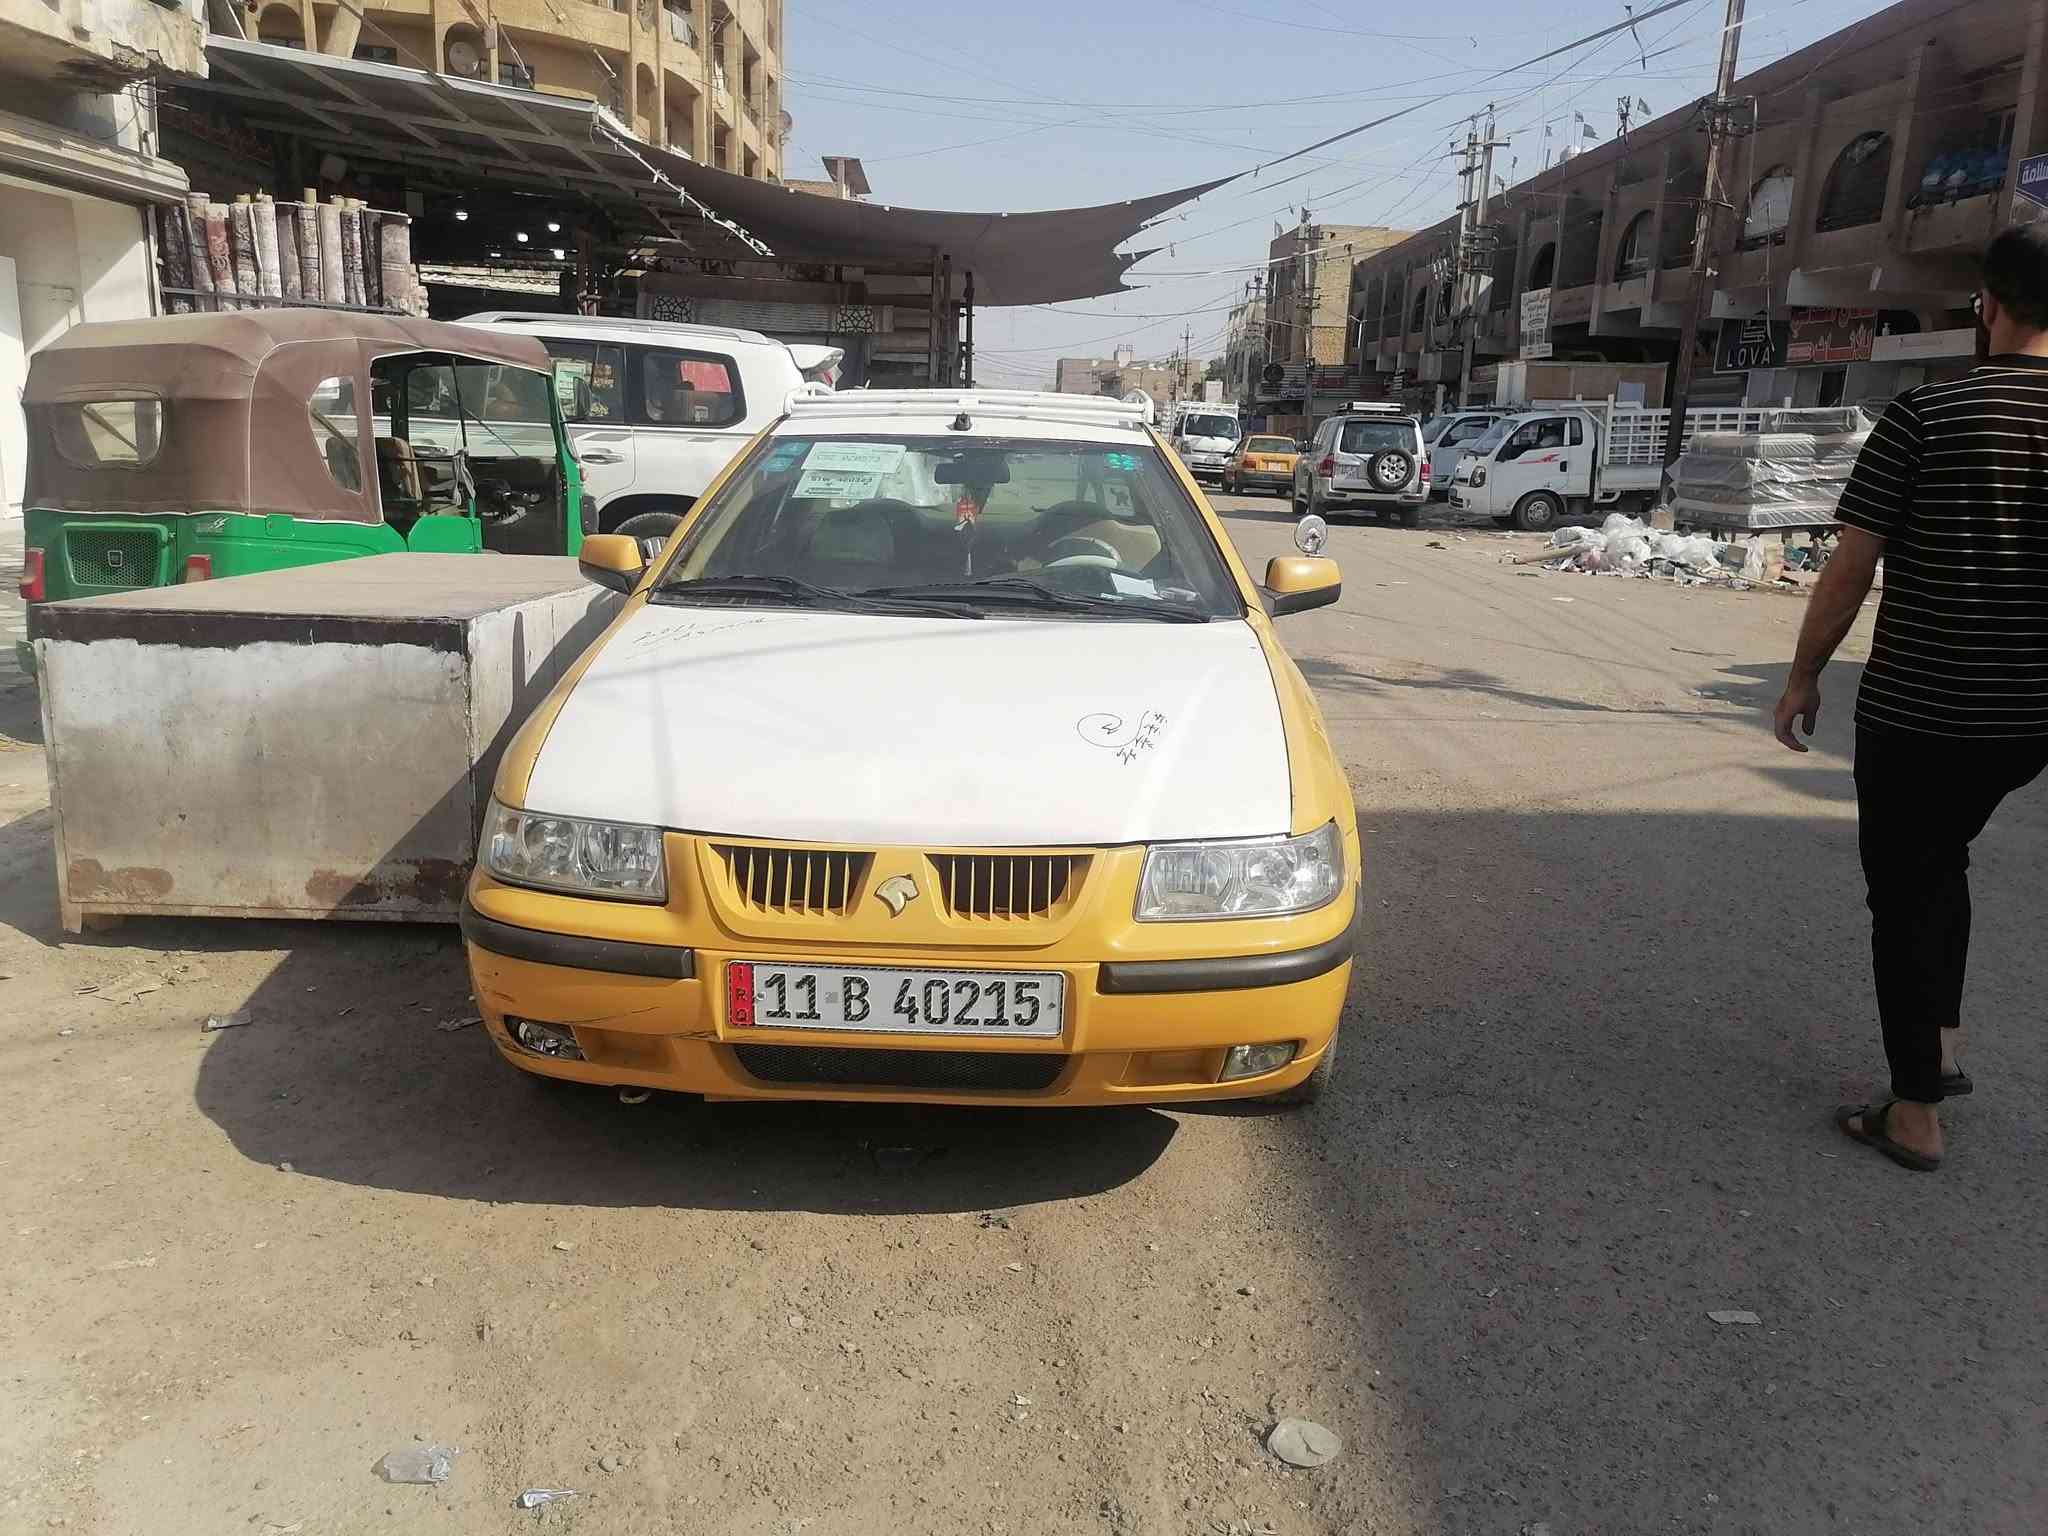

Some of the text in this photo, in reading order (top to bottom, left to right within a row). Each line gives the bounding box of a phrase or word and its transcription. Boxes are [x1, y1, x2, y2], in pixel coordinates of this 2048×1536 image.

[1727, 346, 1770, 368] LOVA
[764, 973, 1041, 1027] 11 B 40215
